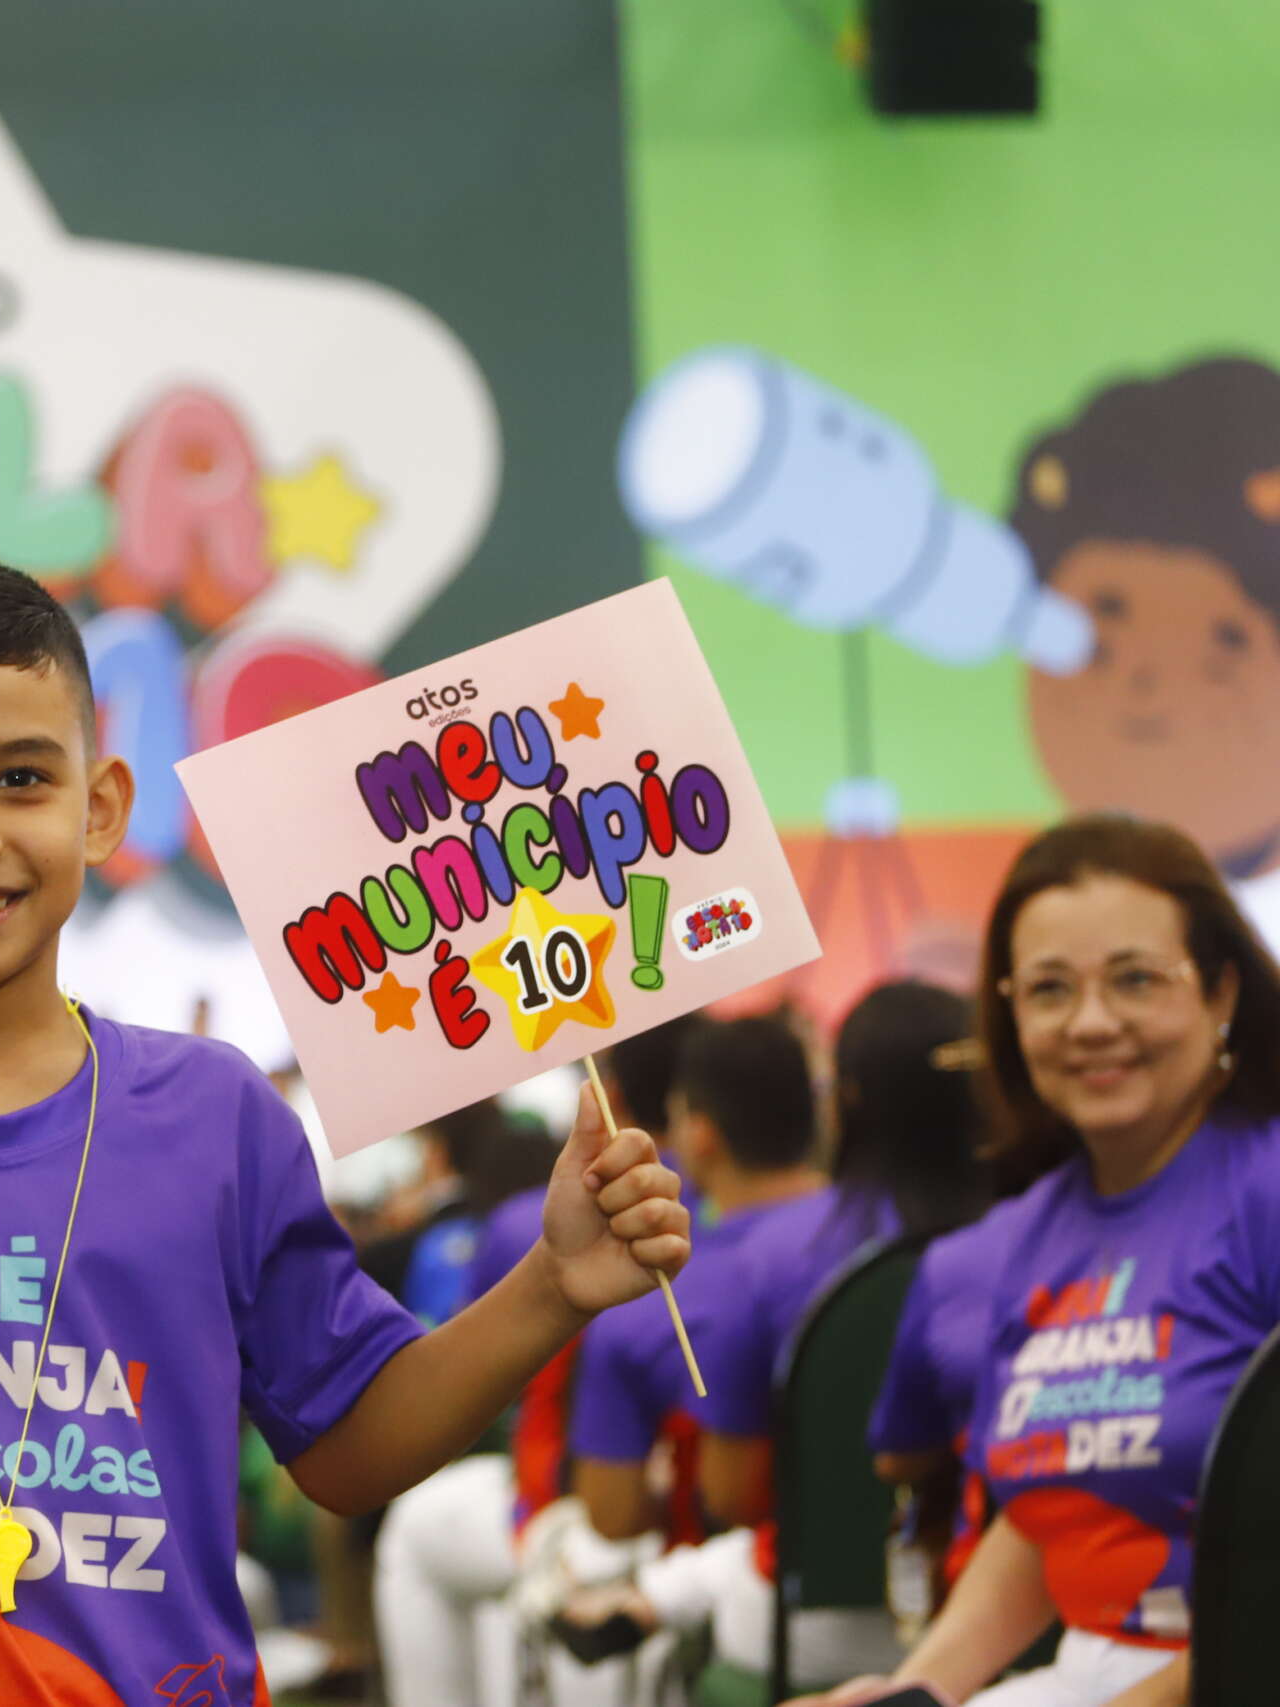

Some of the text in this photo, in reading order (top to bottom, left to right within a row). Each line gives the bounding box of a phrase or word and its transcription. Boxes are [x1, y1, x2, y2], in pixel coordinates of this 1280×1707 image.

[405, 678, 479, 720] atos
[428, 938, 491, 1049] É
[501, 928, 591, 1010] 10
[1065, 1412, 1163, 1475] DEZ
